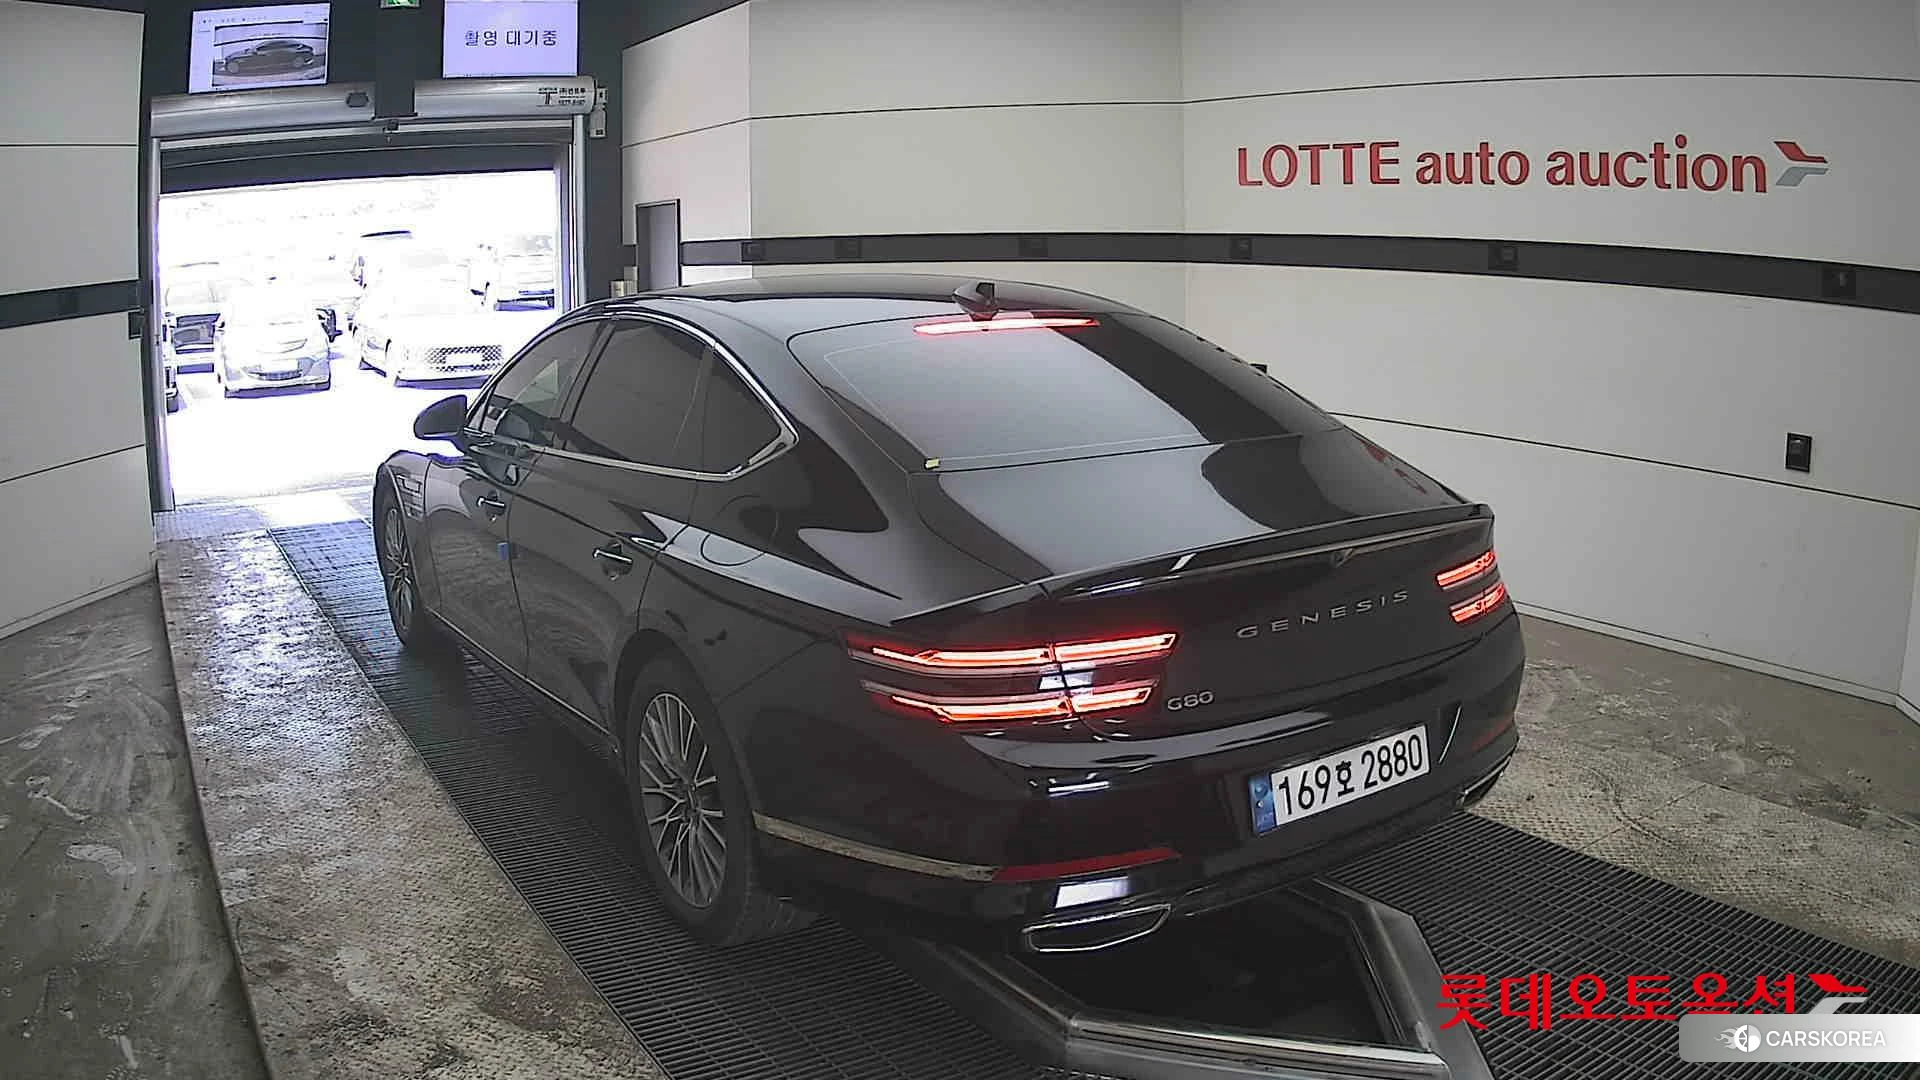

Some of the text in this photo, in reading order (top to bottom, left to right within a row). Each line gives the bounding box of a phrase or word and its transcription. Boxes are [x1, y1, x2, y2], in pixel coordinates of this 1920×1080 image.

[464, 30, 498, 47] 촬영
[1237, 134, 1768, 193] LOTTE auto auction
[1236, 590, 1409, 639] GENESIS
[1167, 690, 1214, 710] G80
[1278, 735, 1423, 815] 169호 2880
